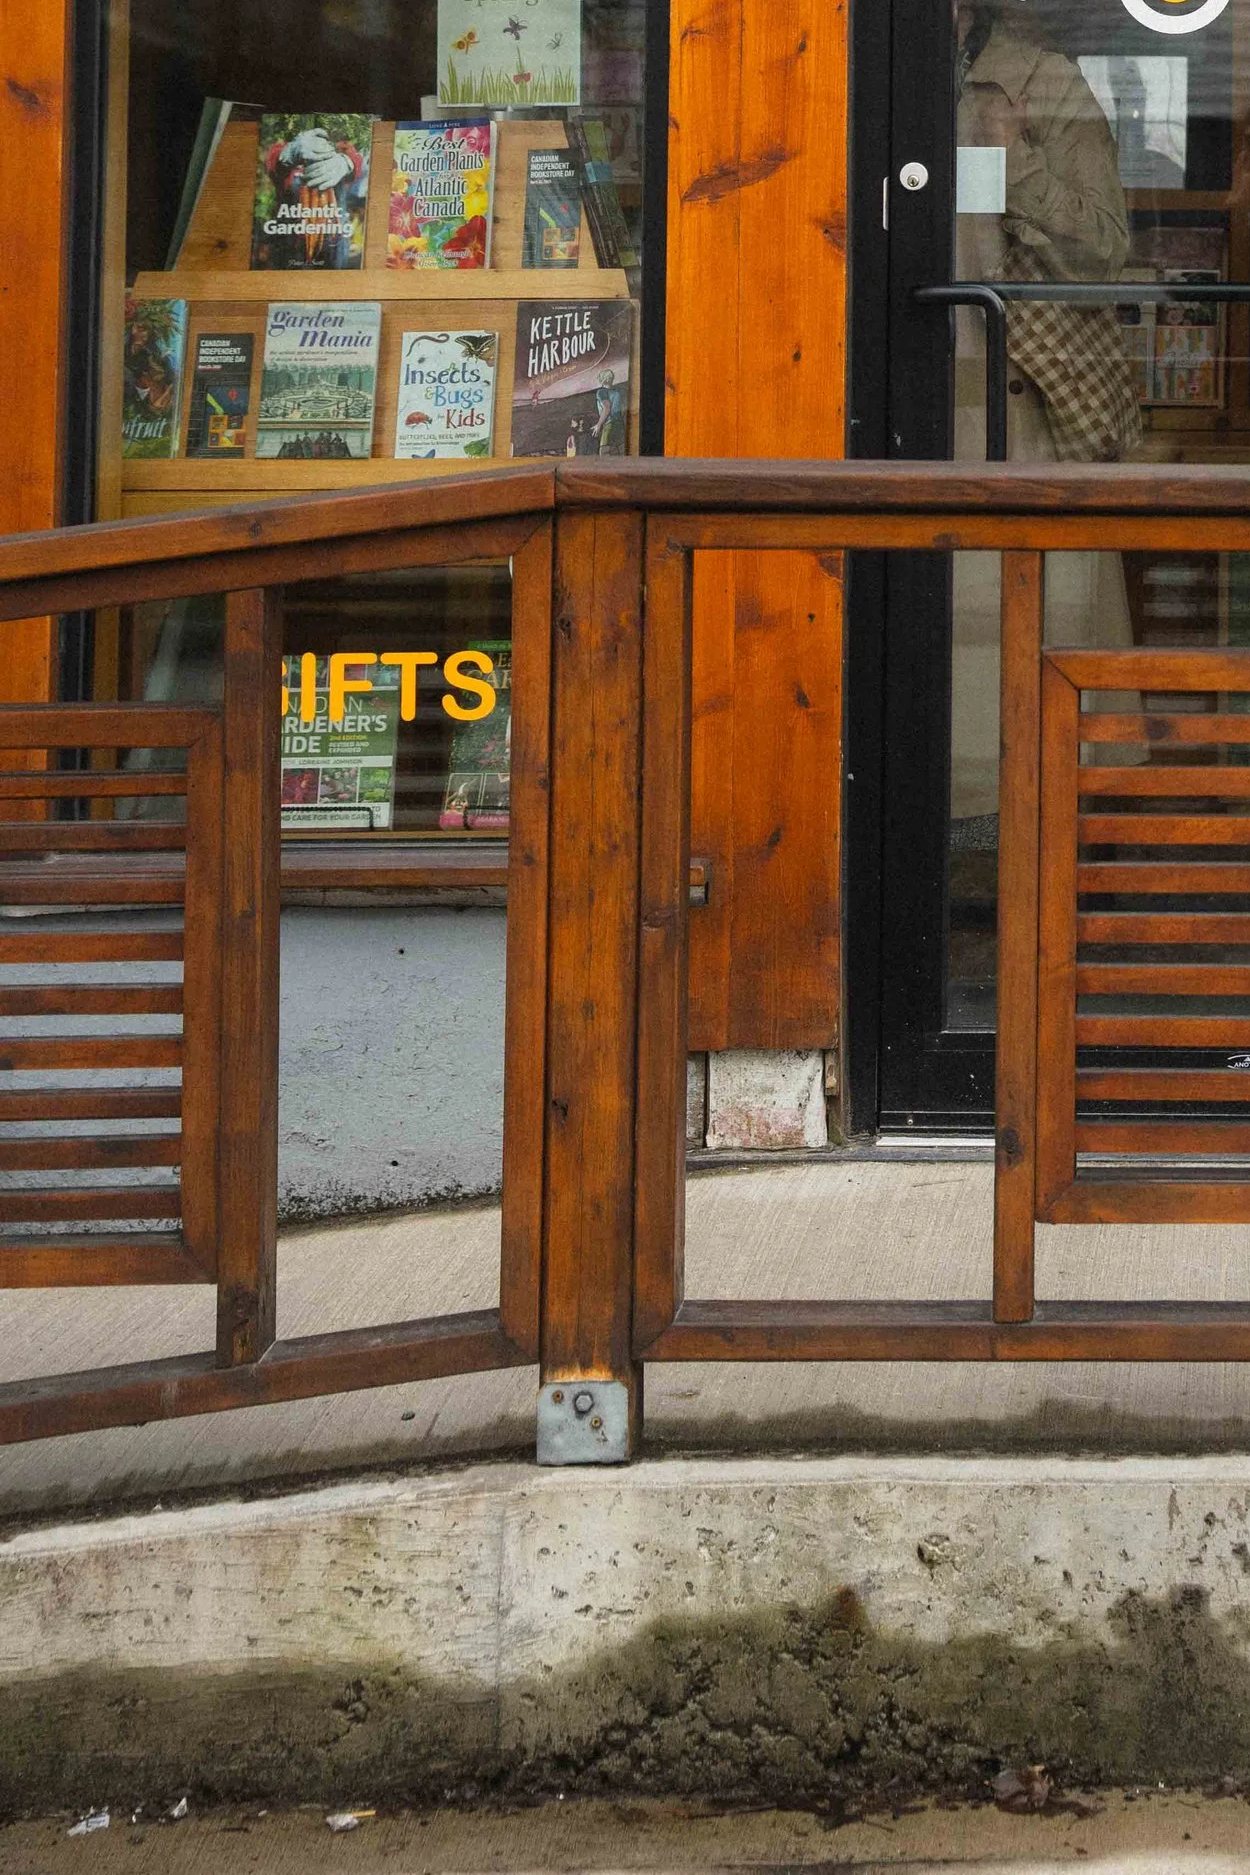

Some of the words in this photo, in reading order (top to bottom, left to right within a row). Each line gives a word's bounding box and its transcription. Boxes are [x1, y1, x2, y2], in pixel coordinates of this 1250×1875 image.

[422, 136, 466, 150] Best
[400, 151, 444, 172] Garden
[447, 151, 484, 171] Plants
[530, 162, 570, 170] INDEPENDENT
[531, 155, 559, 163] CANADIAN
[530, 170, 563, 178] BOOKSTORE
[415, 177, 468, 197] Atlantic
[276, 203, 345, 219] Atlantic
[414, 198, 465, 218] Canada
[263, 219, 355, 238] Gardening
[268, 309, 345, 337] garden
[530, 311, 591, 344] KETTLE
[200, 339, 231, 347] CANADIAN
[298, 330, 373, 347] Mania
[199, 347, 242, 355] INDEPENDENT
[527, 331, 596, 378] HARBOUR
[404, 362, 481, 385] Insects
[434, 385, 484, 409] Bugs
[446, 408, 486, 429] Kids
[282, 714, 388, 734] RDENER'S
[281, 735, 322, 754] IDE
